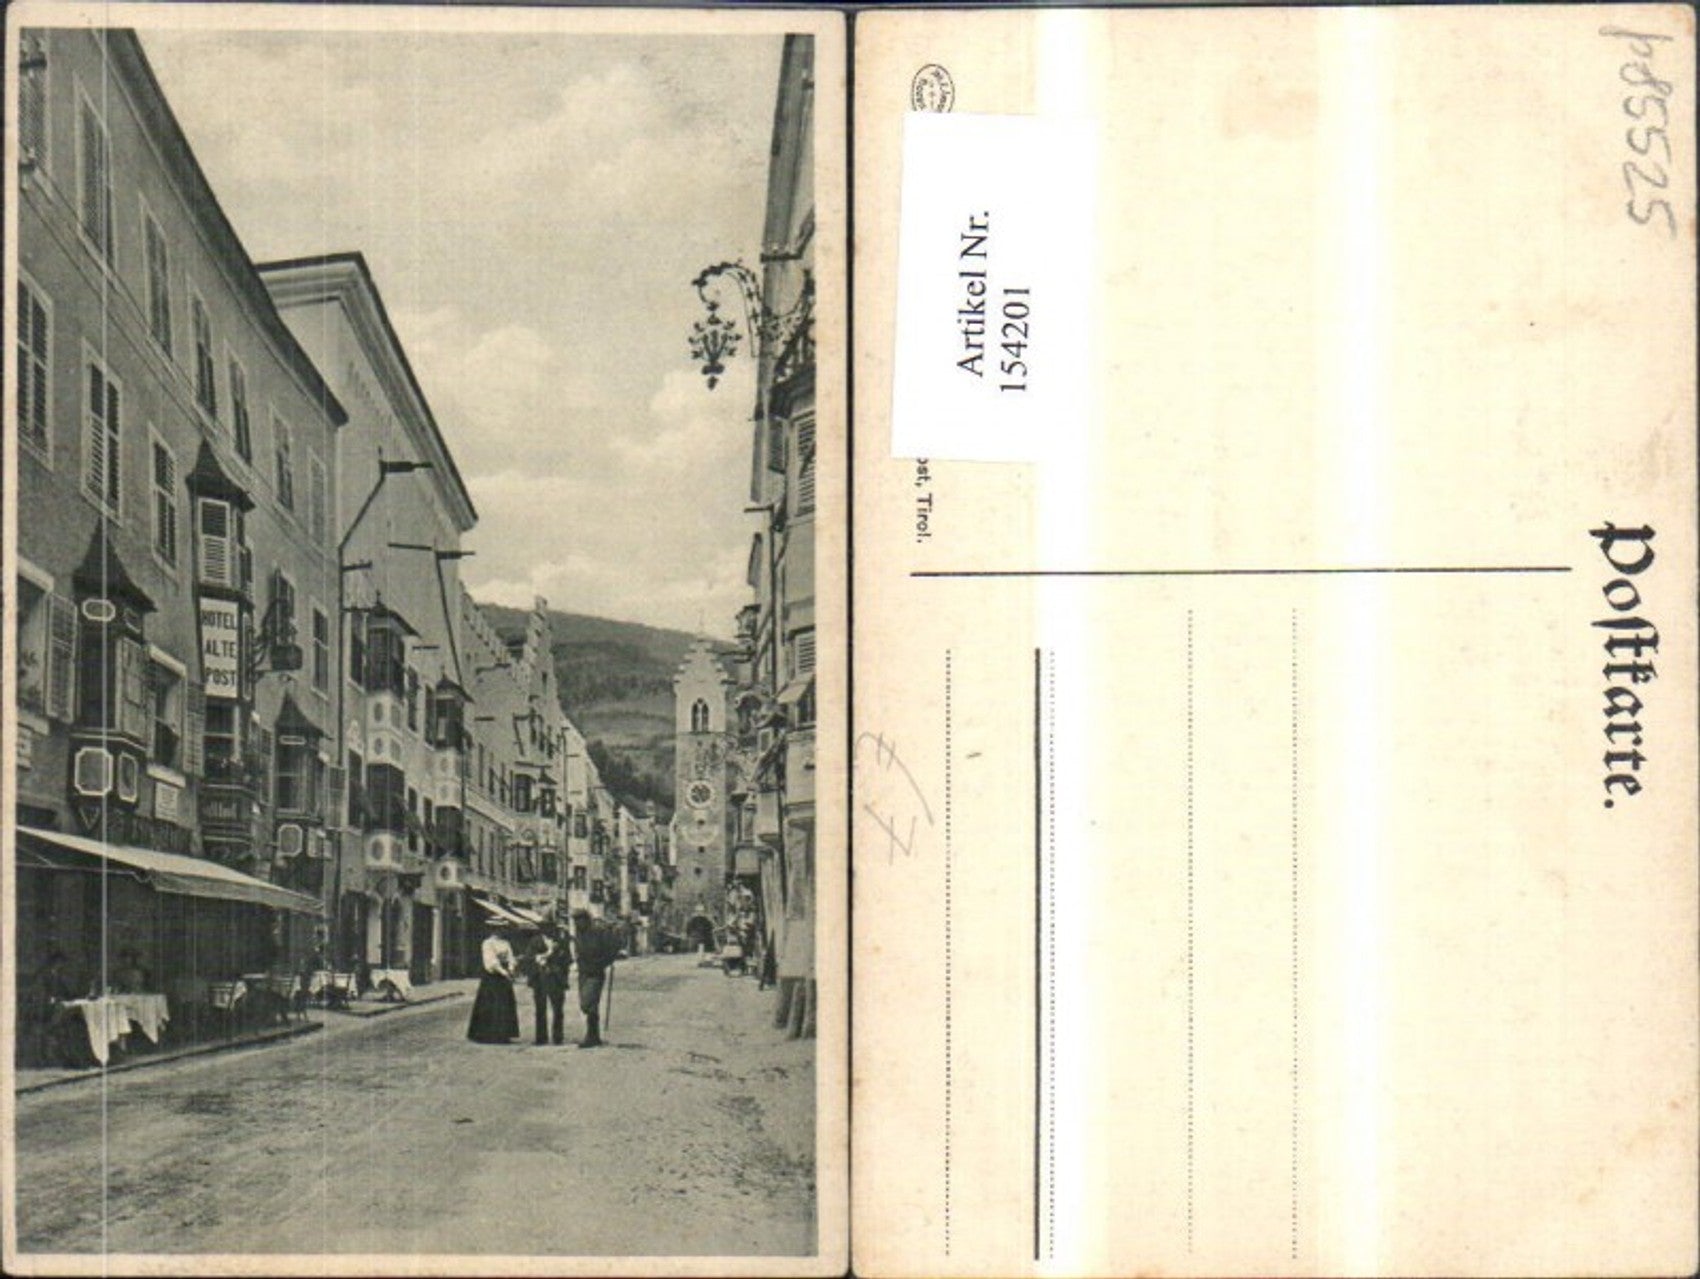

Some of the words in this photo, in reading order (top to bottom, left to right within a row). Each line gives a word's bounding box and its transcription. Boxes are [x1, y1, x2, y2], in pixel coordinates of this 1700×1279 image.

[960, 209, 990, 259] Nr.
[957, 270, 988, 377] Artikel
[1000, 286, 1031, 392] 154201
[915, 492, 934, 544] Tirol.
[202, 610, 237, 631] HOTEL
[205, 639, 237, 658] ALTE
[205, 667, 237, 687] POST
